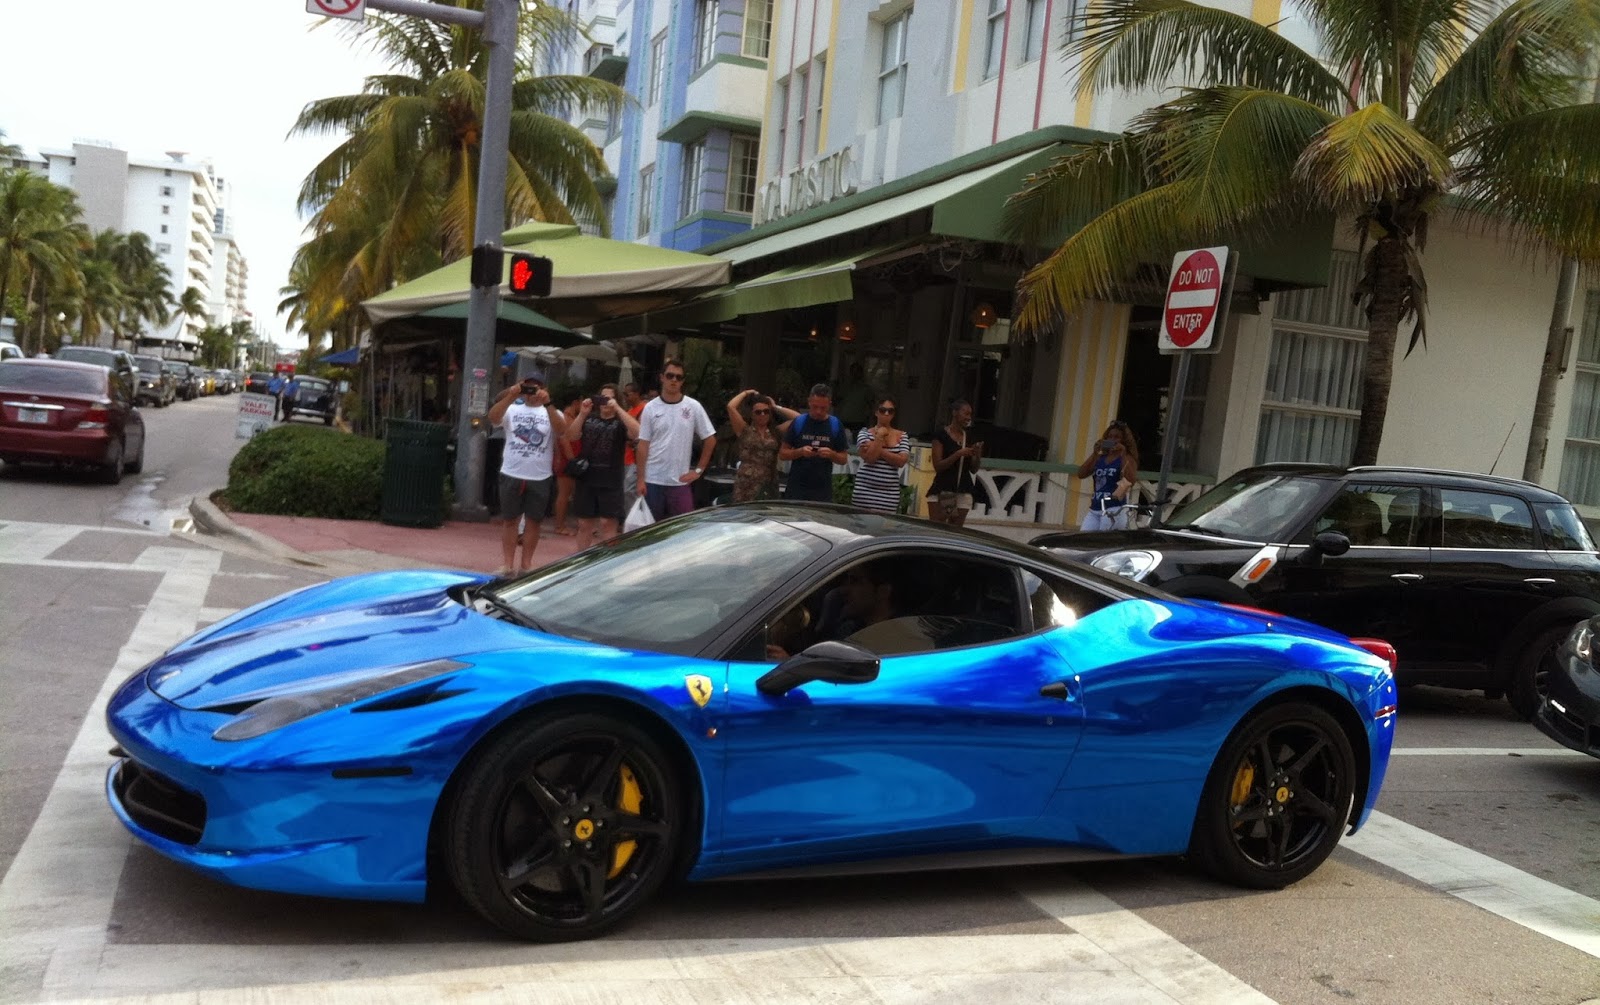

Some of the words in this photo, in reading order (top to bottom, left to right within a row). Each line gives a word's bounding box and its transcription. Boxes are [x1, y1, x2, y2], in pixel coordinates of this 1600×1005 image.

[1178, 270, 1192, 286] DO
[1194, 267, 1214, 284] NOT
[1172, 313, 1203, 329] ENTER
[240, 406, 272, 417] PARKING
[244, 400, 268, 410] VALET
